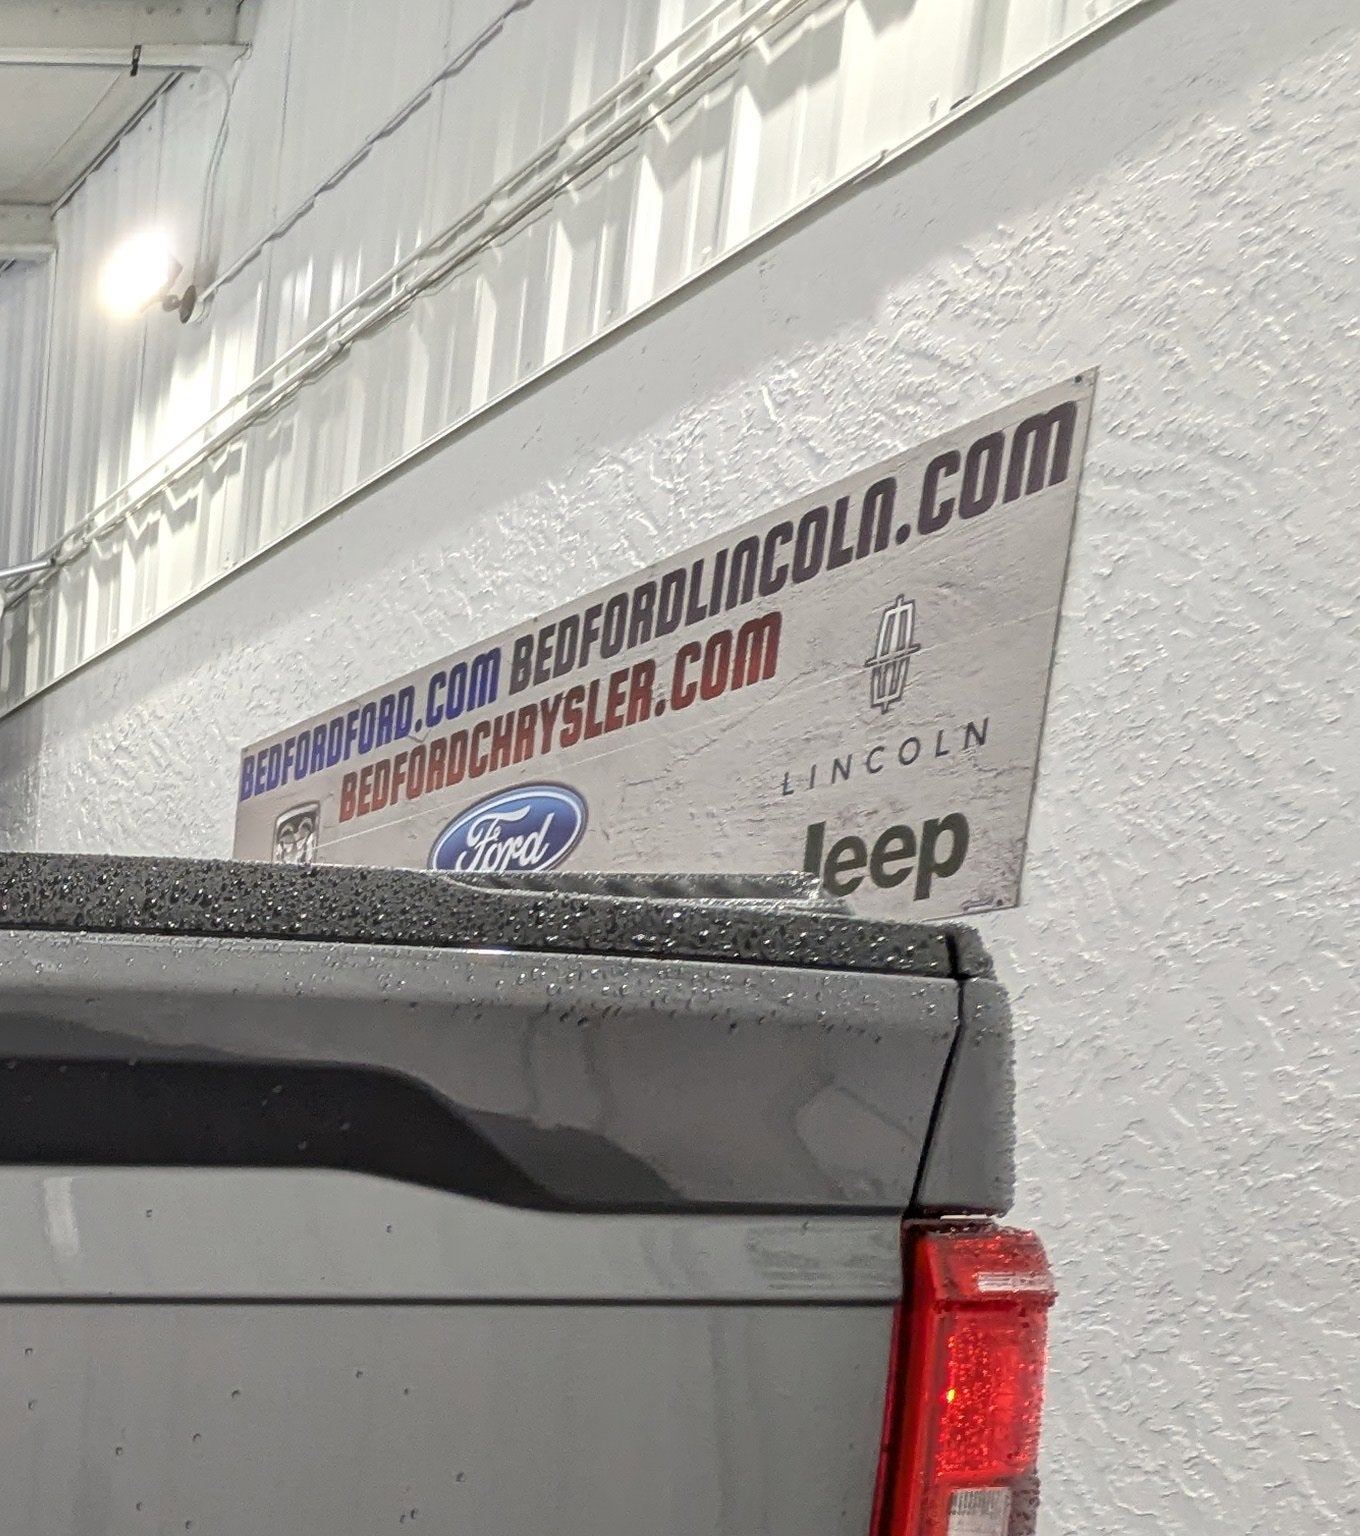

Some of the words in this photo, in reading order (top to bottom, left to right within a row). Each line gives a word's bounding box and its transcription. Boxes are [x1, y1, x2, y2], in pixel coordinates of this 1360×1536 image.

[239, 649, 501, 801] BEDFORDFORD.COM
[339, 611, 782, 822] BEDFORDCHRYSLER.COM
[781, 717, 989, 796] LINCOLN
[455, 805, 555, 872] Ford
[803, 812, 970, 901] Jeep
